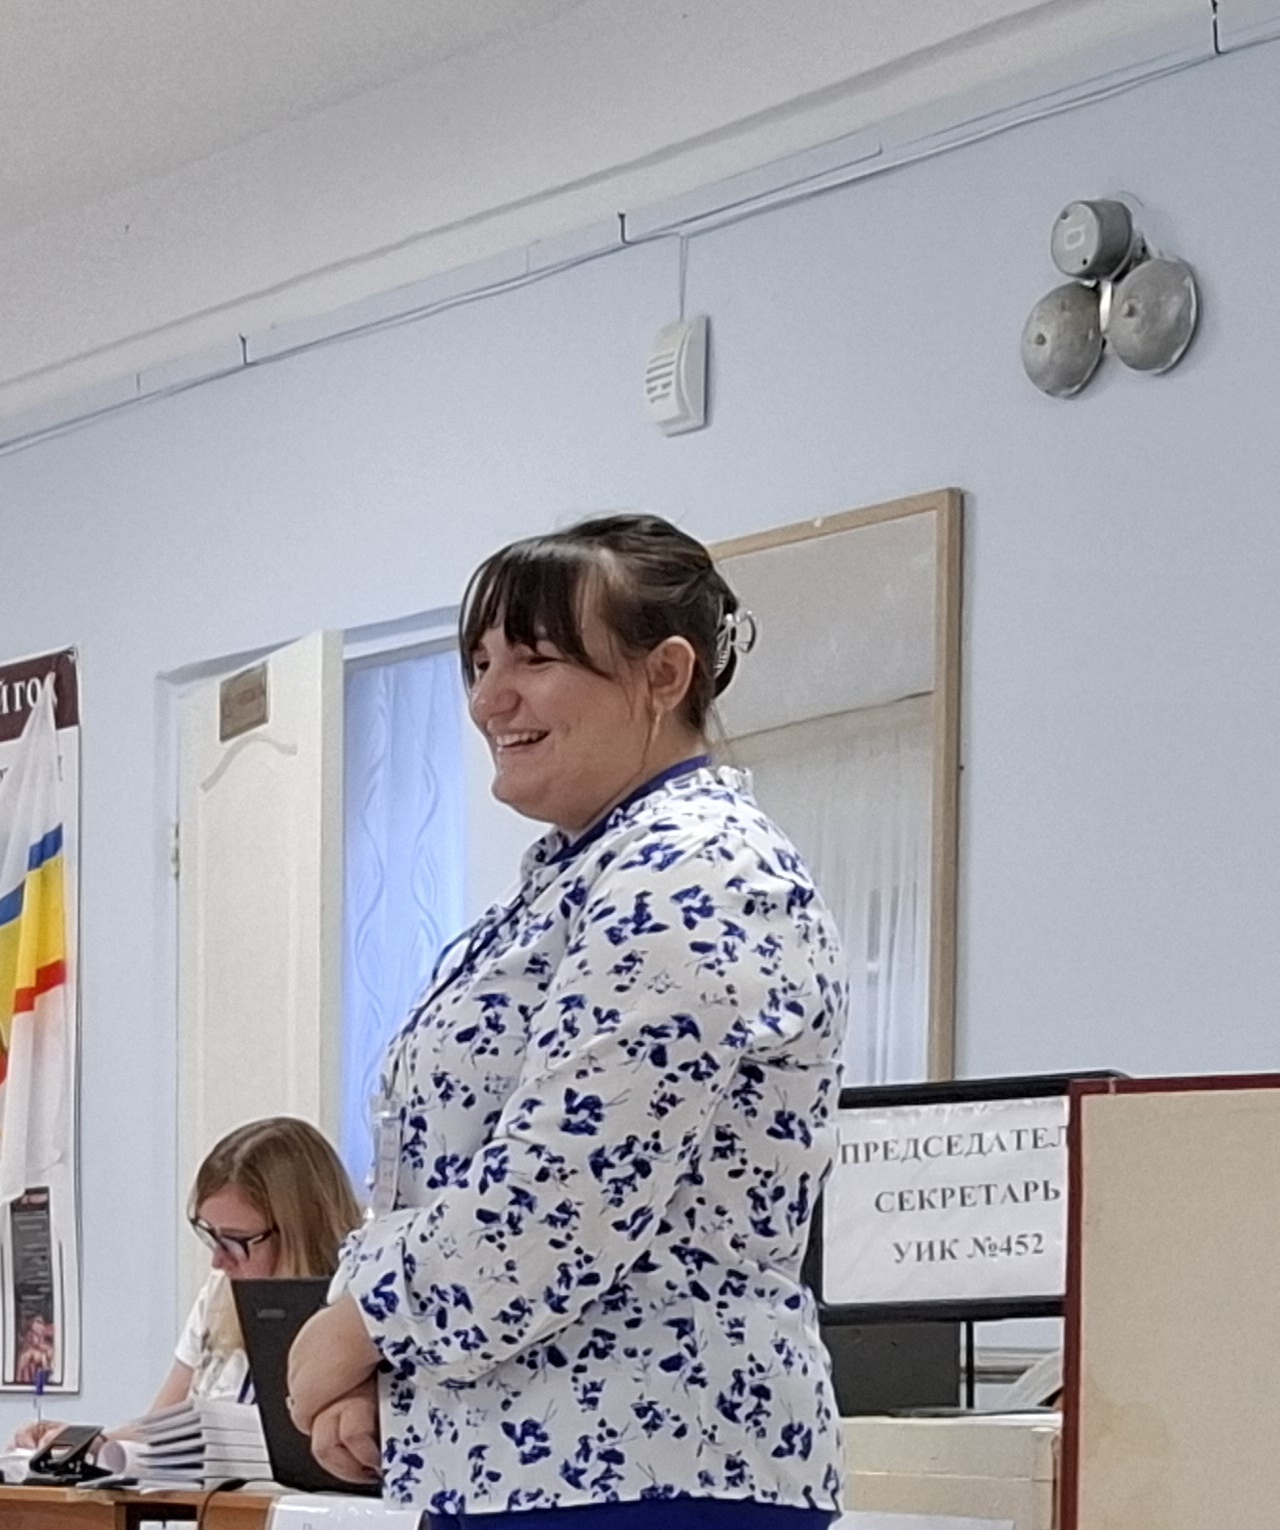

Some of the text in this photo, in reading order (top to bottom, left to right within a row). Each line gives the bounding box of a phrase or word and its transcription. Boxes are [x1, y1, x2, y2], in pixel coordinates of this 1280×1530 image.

[12, 675, 57, 713] ГО
[841, 1126, 1067, 1164] ПРЕДСЕДАТЕЛ
[874, 1180, 1061, 1213] СЕКРЕТАРЬ
[893, 1233, 1044, 1263] УИК №452
